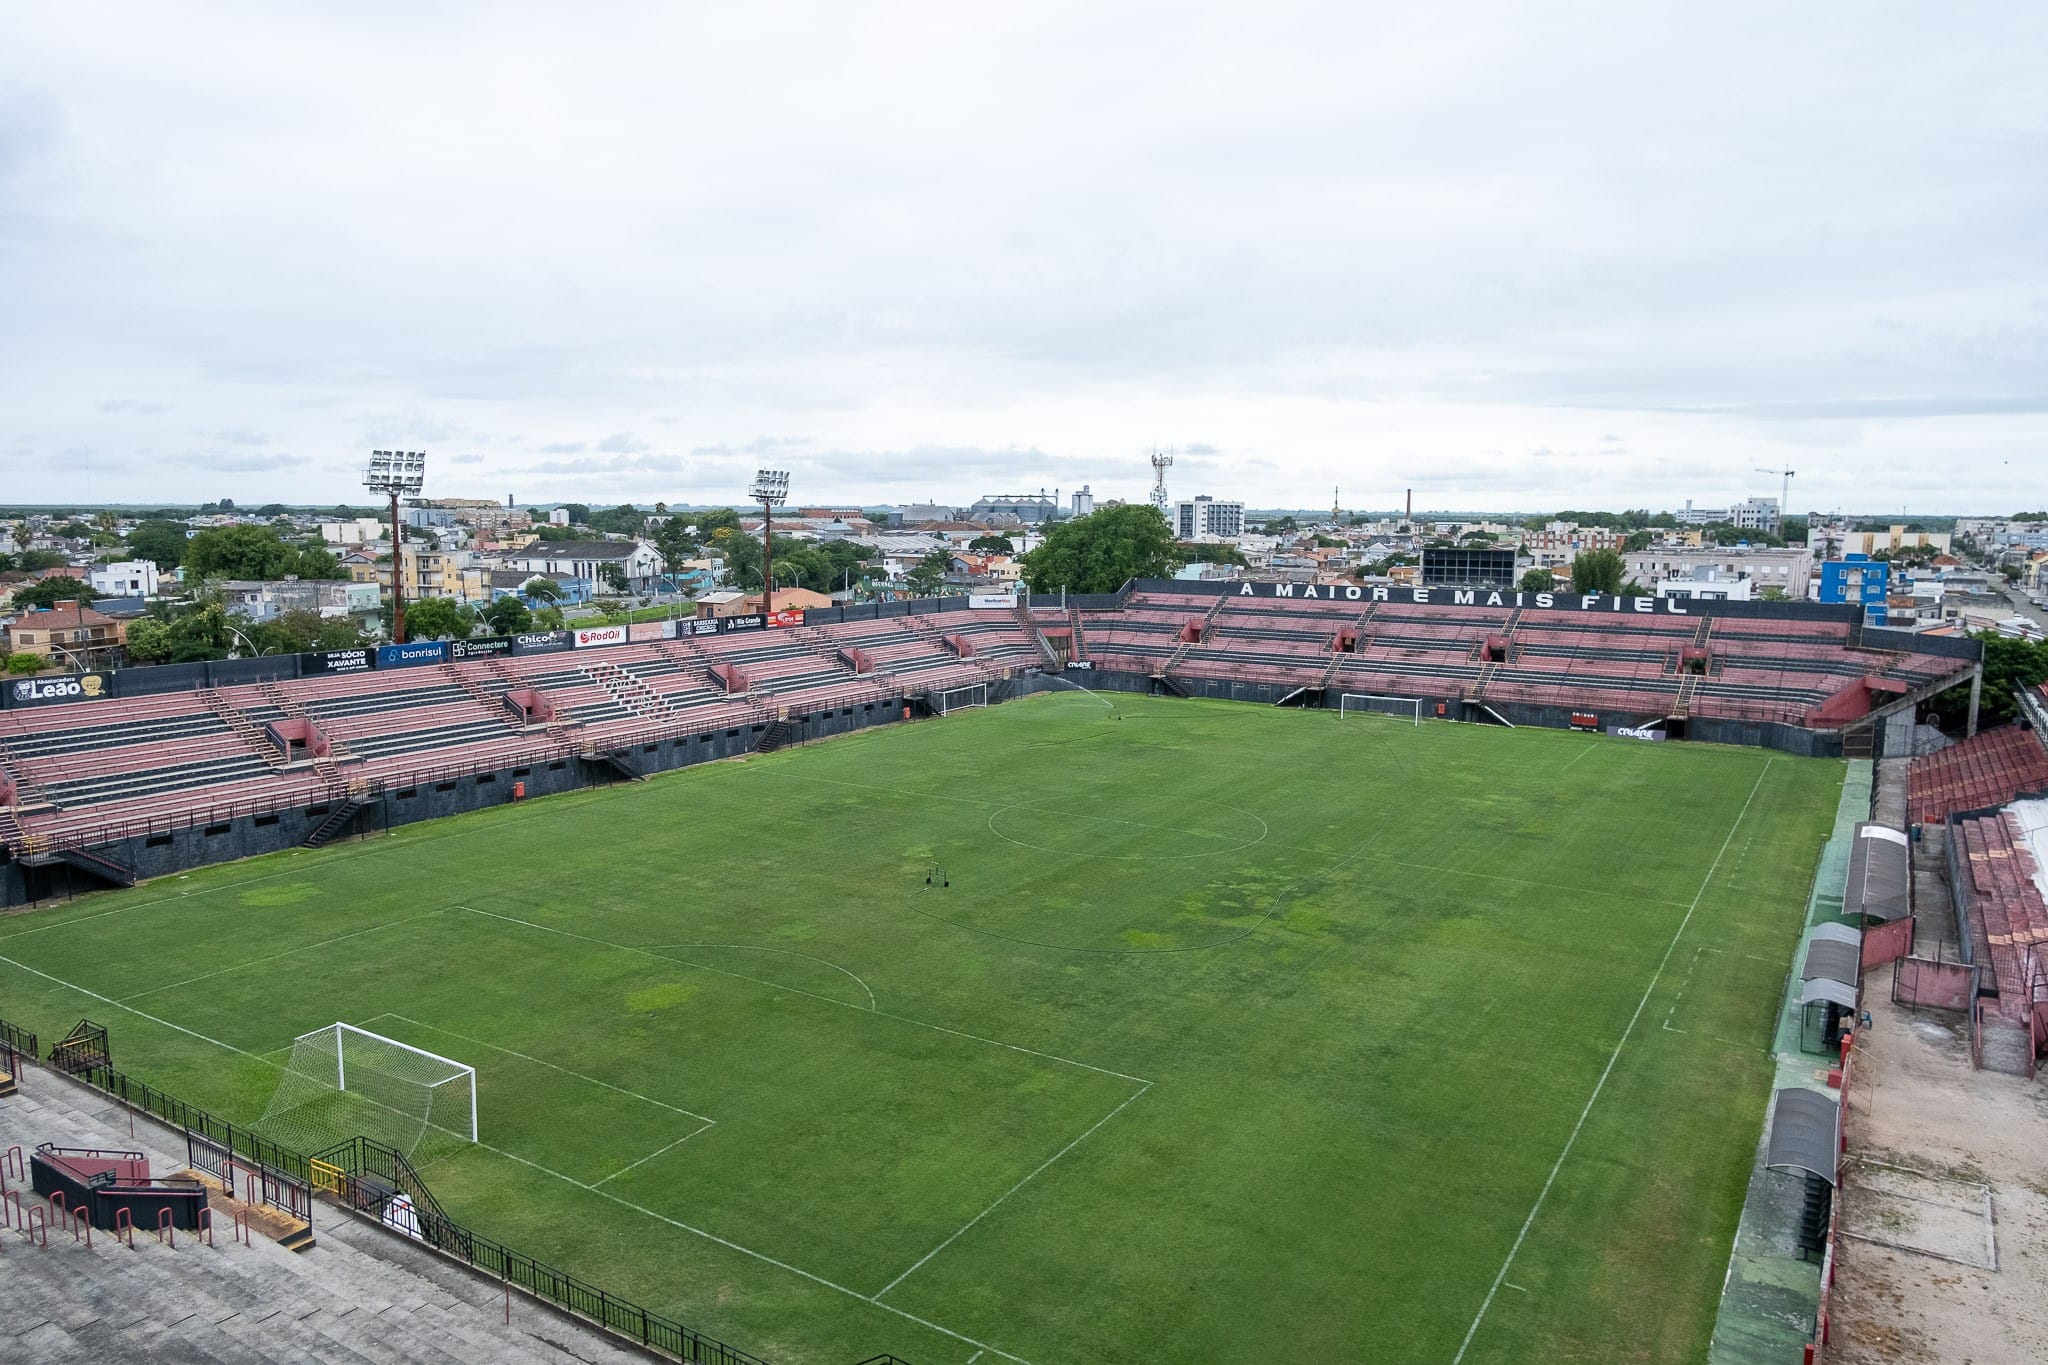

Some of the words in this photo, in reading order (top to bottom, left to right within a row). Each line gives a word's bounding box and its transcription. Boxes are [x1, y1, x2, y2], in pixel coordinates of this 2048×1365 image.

[1240, 582, 1254, 596] A
[1275, 583, 1389, 601] MAIOR
[1413, 588, 1429, 603] E
[1454, 590, 1554, 608] MAIS
[1581, 595, 1688, 614] FIEL
[590, 630, 620, 641] RodOil
[467, 640, 509, 651] Connectere
[341, 650, 366, 659] SÓCIO
[401, 646, 442, 659] banrisul
[327, 657, 366, 668] XAVANTE
